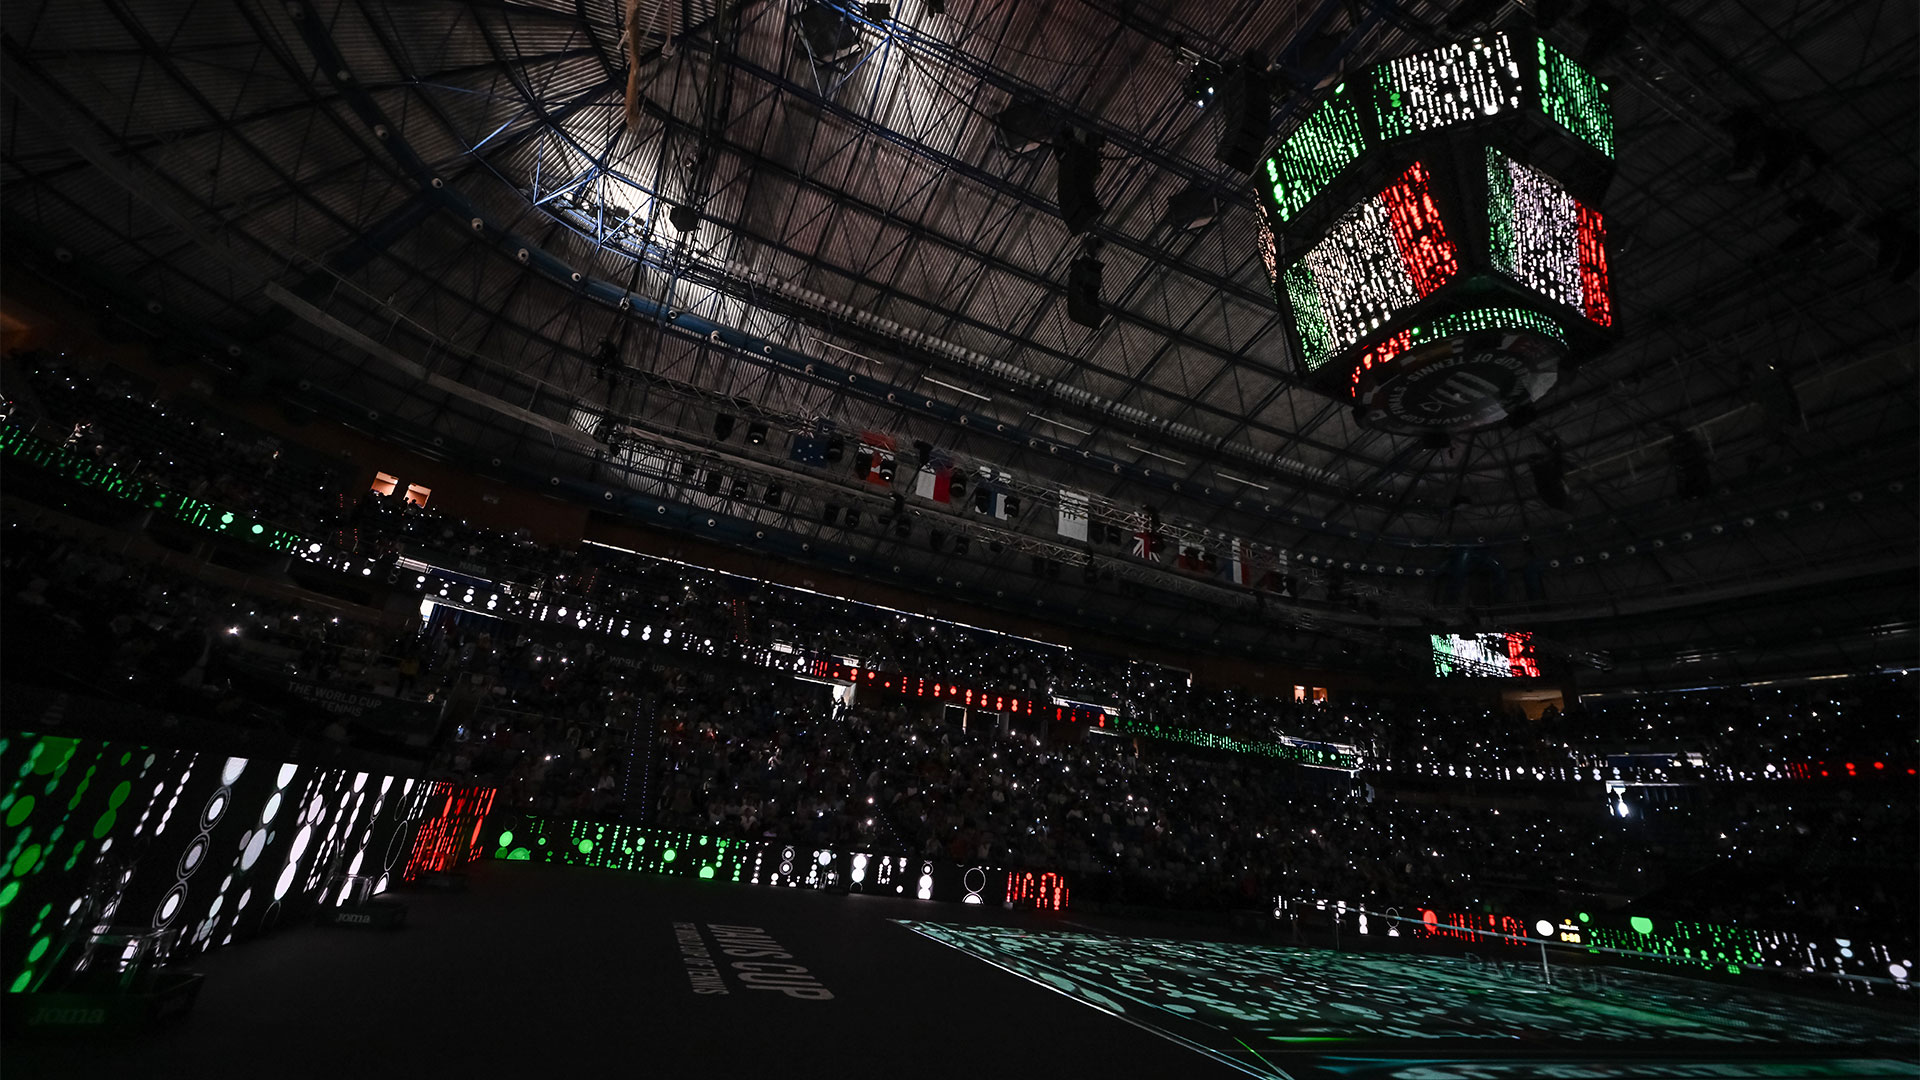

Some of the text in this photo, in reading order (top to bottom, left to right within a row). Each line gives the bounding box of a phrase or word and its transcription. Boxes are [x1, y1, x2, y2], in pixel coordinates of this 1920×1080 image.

[288, 681, 382, 709] THE WORLD CUP
[321, 700, 362, 718] TENNIS
[706, 923, 835, 1000] DAVIS CUP
[687, 967, 730, 995] TENNIS
